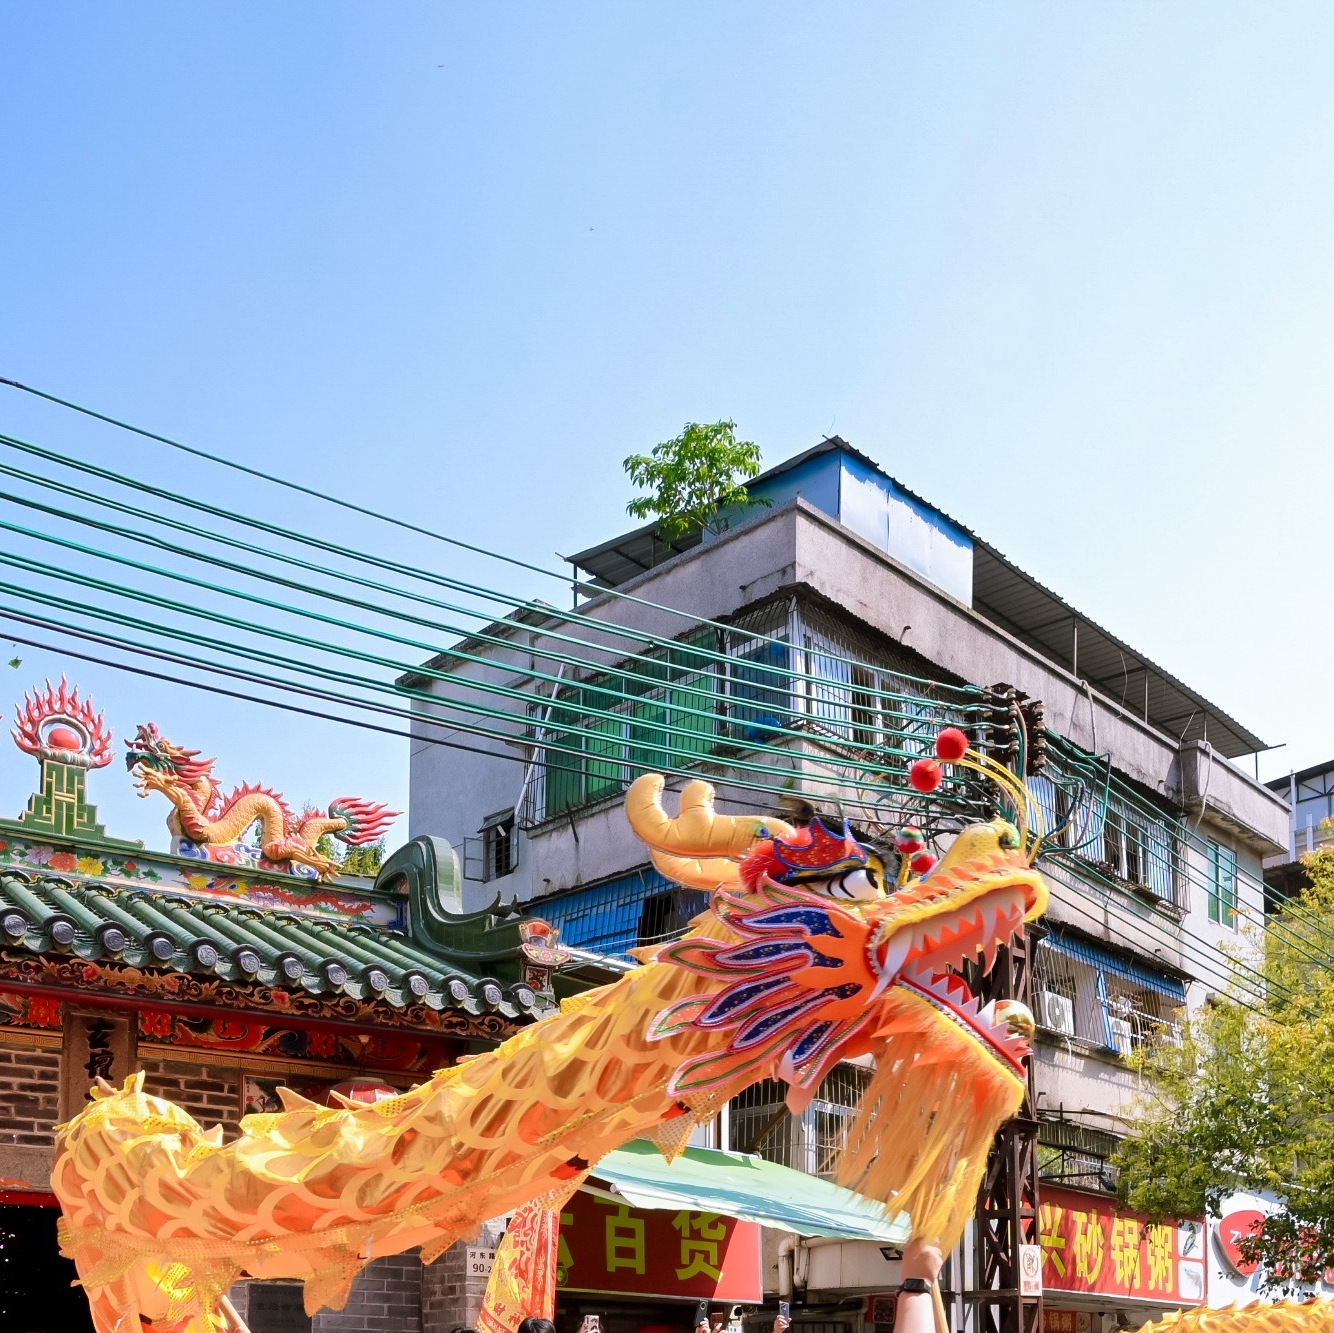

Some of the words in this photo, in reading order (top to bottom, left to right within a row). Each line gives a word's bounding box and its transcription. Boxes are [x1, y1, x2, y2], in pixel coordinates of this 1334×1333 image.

[84, 1017, 116, 1100] 玄壇
[469, 1251, 495, 1260] 河东路
[1007, 1201, 1174, 1293] 兴砂锅粥
[1043, 1311, 1072, 1332] 锅粥
